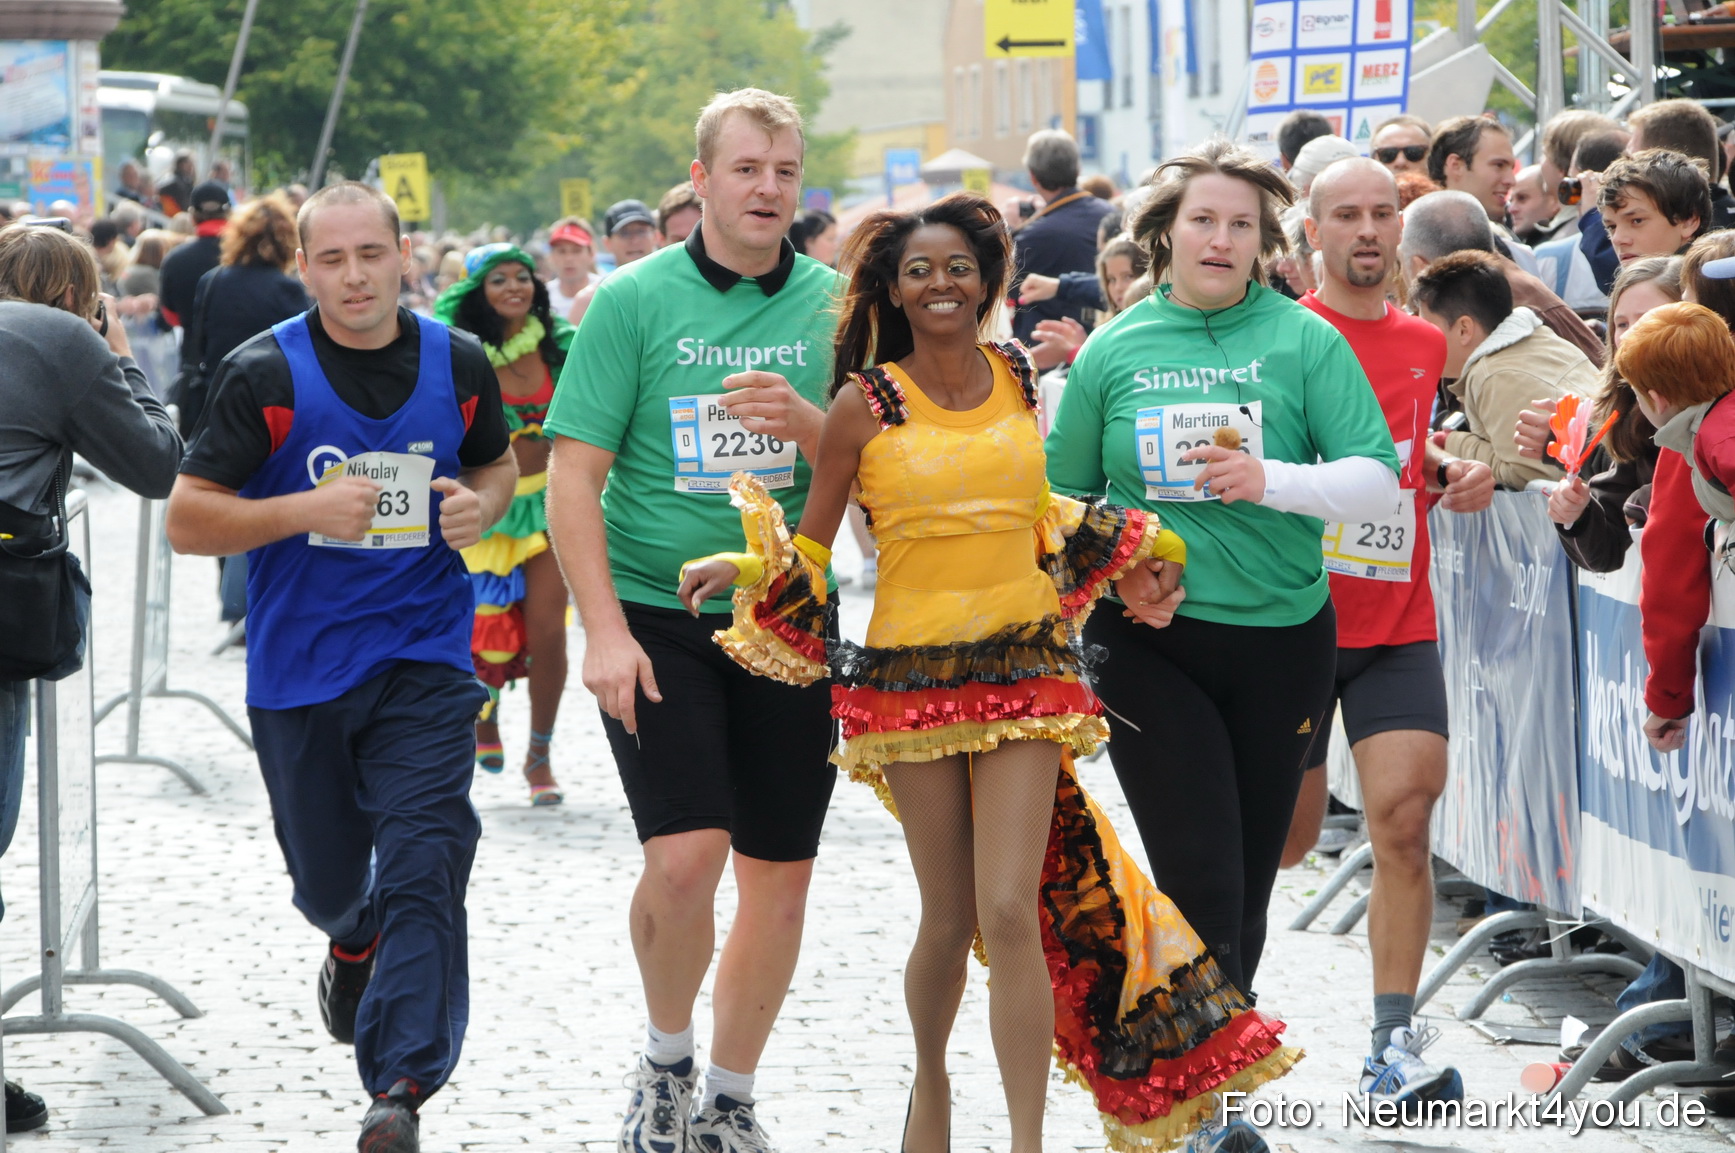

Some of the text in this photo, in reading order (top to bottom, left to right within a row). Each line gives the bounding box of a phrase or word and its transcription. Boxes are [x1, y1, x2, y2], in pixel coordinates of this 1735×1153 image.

[1362, 62, 1399, 78] MERZ
[394, 174, 417, 204] A
[676, 337, 807, 372] Sinupret
[1132, 358, 1262, 394] Sinupret
[1172, 412, 1229, 430] Martina
[682, 434, 690, 447] D
[711, 431, 784, 458] 2236
[1146, 441, 1154, 456] D
[347, 461, 399, 482] Nikolay
[385, 532, 426, 542] PFLEIDERER
[1356, 522, 1405, 551] 233
